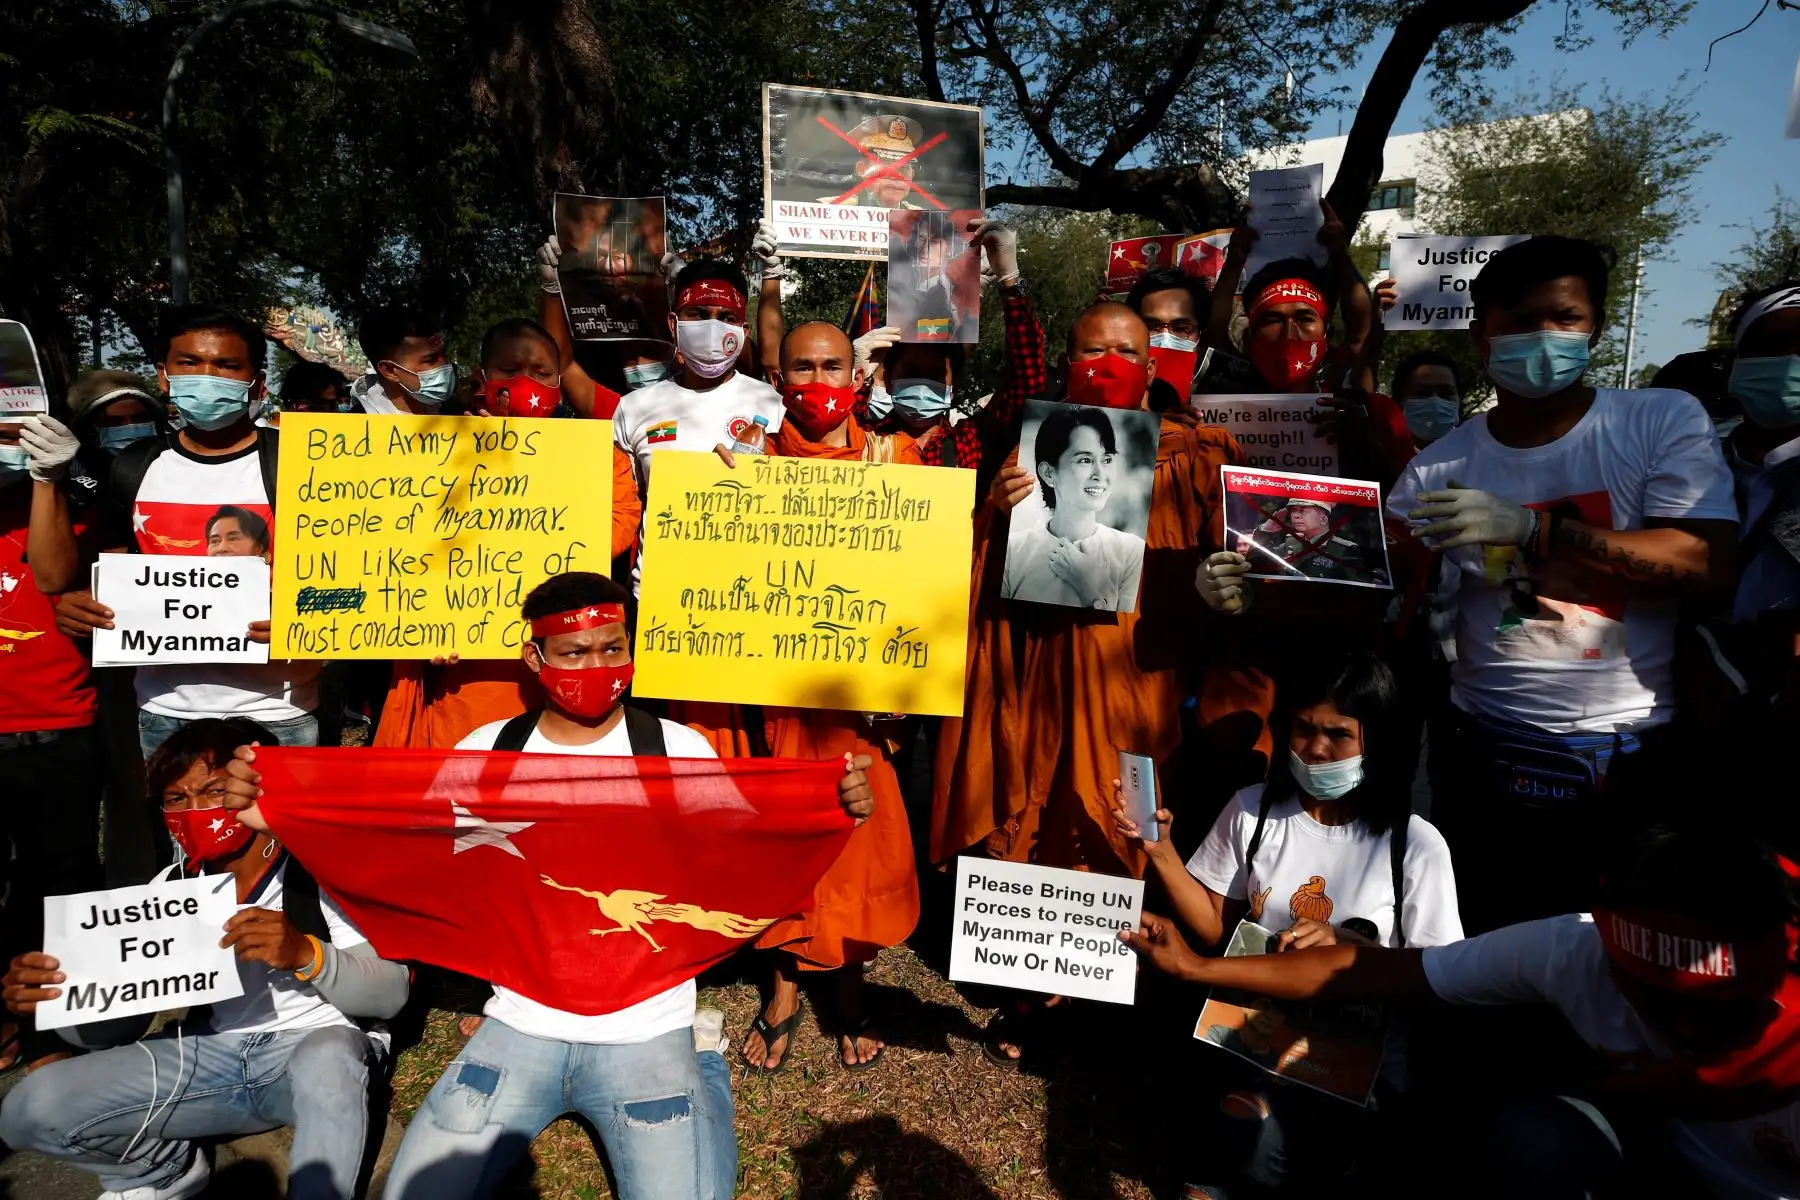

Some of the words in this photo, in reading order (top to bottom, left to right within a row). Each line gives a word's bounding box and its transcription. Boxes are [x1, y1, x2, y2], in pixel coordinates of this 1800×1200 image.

[780, 205, 831, 219] SHAME
[838, 208, 859, 221] ON
[788, 226, 812, 239] WE
[820, 228, 867, 242] NEVER
[1282, 289, 1318, 302] NLD
[308, 420, 372, 461] Bad
[389, 425, 458, 466] Army
[472, 420, 541, 457] robs
[1282, 452, 1333, 471] Coup
[298, 466, 459, 510] democracy
[469, 463, 529, 502] from
[396, 503, 423, 534] of
[134, 565, 240, 589] Justice
[296, 551, 337, 580] UN
[448, 544, 523, 579] Police
[543, 542, 586, 576] of
[766, 559, 816, 589] UN
[164, 598, 212, 620] For
[378, 576, 427, 611] the
[349, 617, 456, 650] condemn
[468, 611, 494, 645] of
[563, 613, 585, 625] NLD
[121, 629, 251, 656] Myanmar
[968, 873, 1034, 897] Please
[1040, 882, 1096, 908] Bring
[1102, 891, 1133, 910] UN
[80, 896, 199, 931] Justice
[963, 896, 1031, 919] Forces
[1038, 905, 1058, 922] to
[1064, 912, 1132, 931] rescue
[120, 936, 175, 963] For
[962, 920, 1055, 946] Myanmar
[1060, 931, 1130, 958] People
[1656, 932, 1738, 978] BURMA
[974, 946, 1018, 968] Now
[1024, 953, 1049, 972] Or
[1054, 956, 1114, 982] Never
[65, 970, 219, 1014] Myanmar
